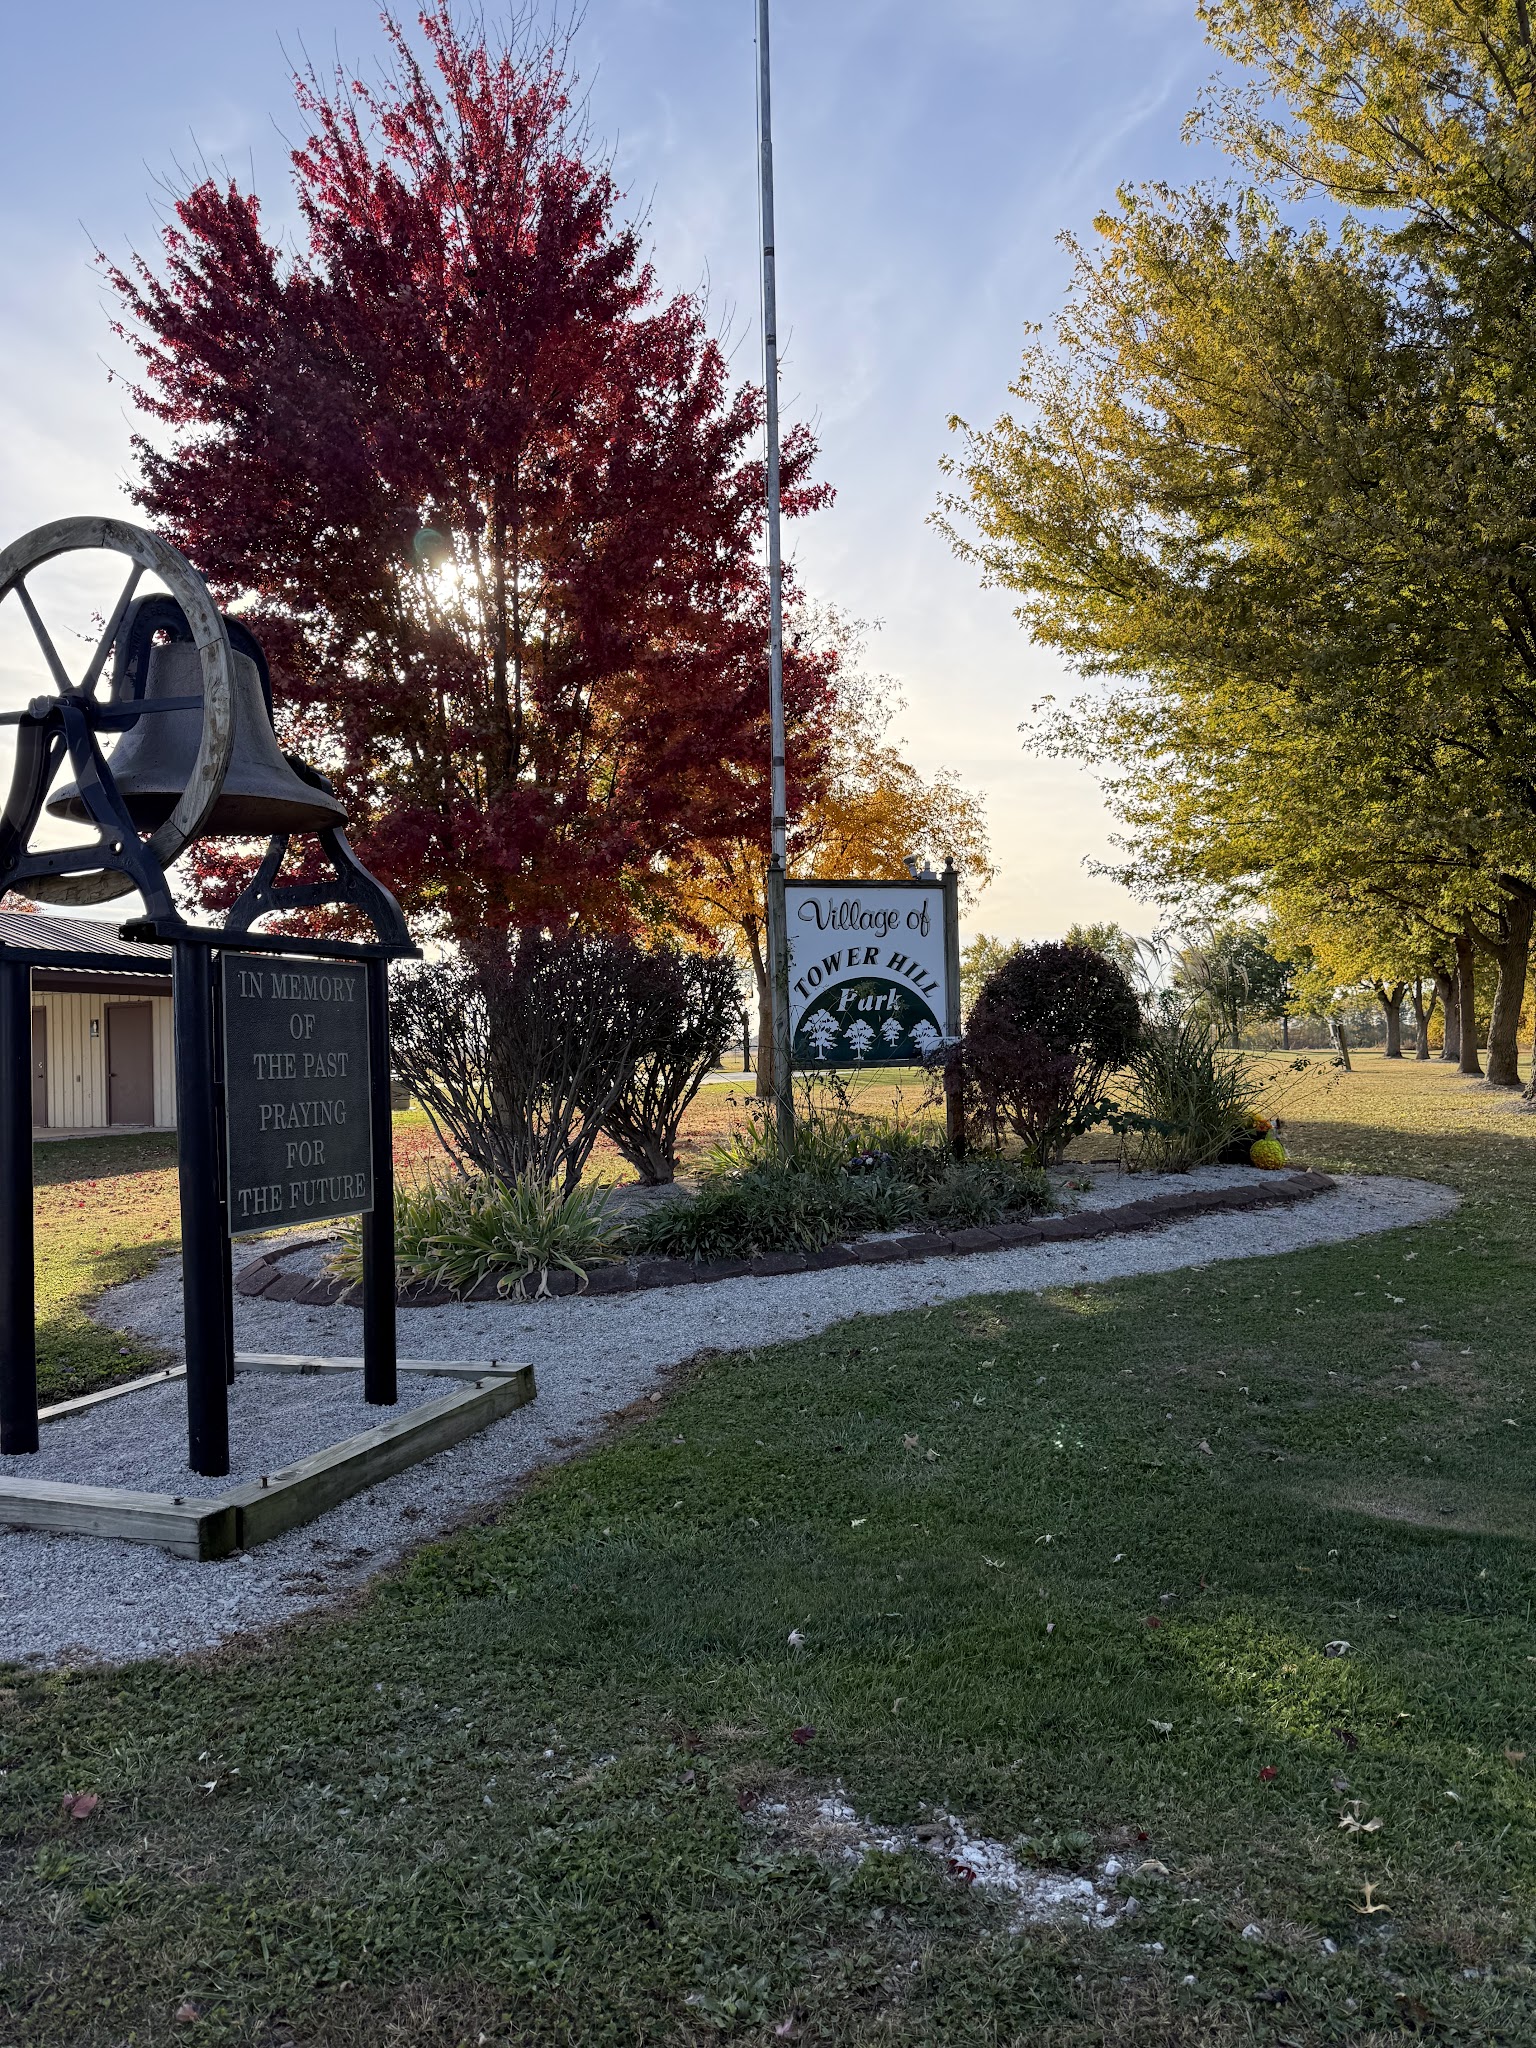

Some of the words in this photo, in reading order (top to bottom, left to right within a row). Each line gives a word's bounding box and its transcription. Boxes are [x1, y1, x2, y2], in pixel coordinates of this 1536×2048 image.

[797, 898, 900, 938] Village
[906, 898, 931, 938] of
[239, 970, 264, 999] IN
[270, 973, 356, 1002] MEMORY
[793, 946, 880, 1000] TOWER
[886, 951, 941, 999] HILL
[835, 988, 904, 1012] Park
[289, 1013, 316, 1040] OF
[253, 1053, 297, 1080] THE
[302, 1052, 349, 1079] PAST
[259, 1099, 347, 1132] PRAYING
[285, 1139, 326, 1169] FOR
[238, 1184, 283, 1217] THE
[288, 1172, 366, 1210] FUTURE
